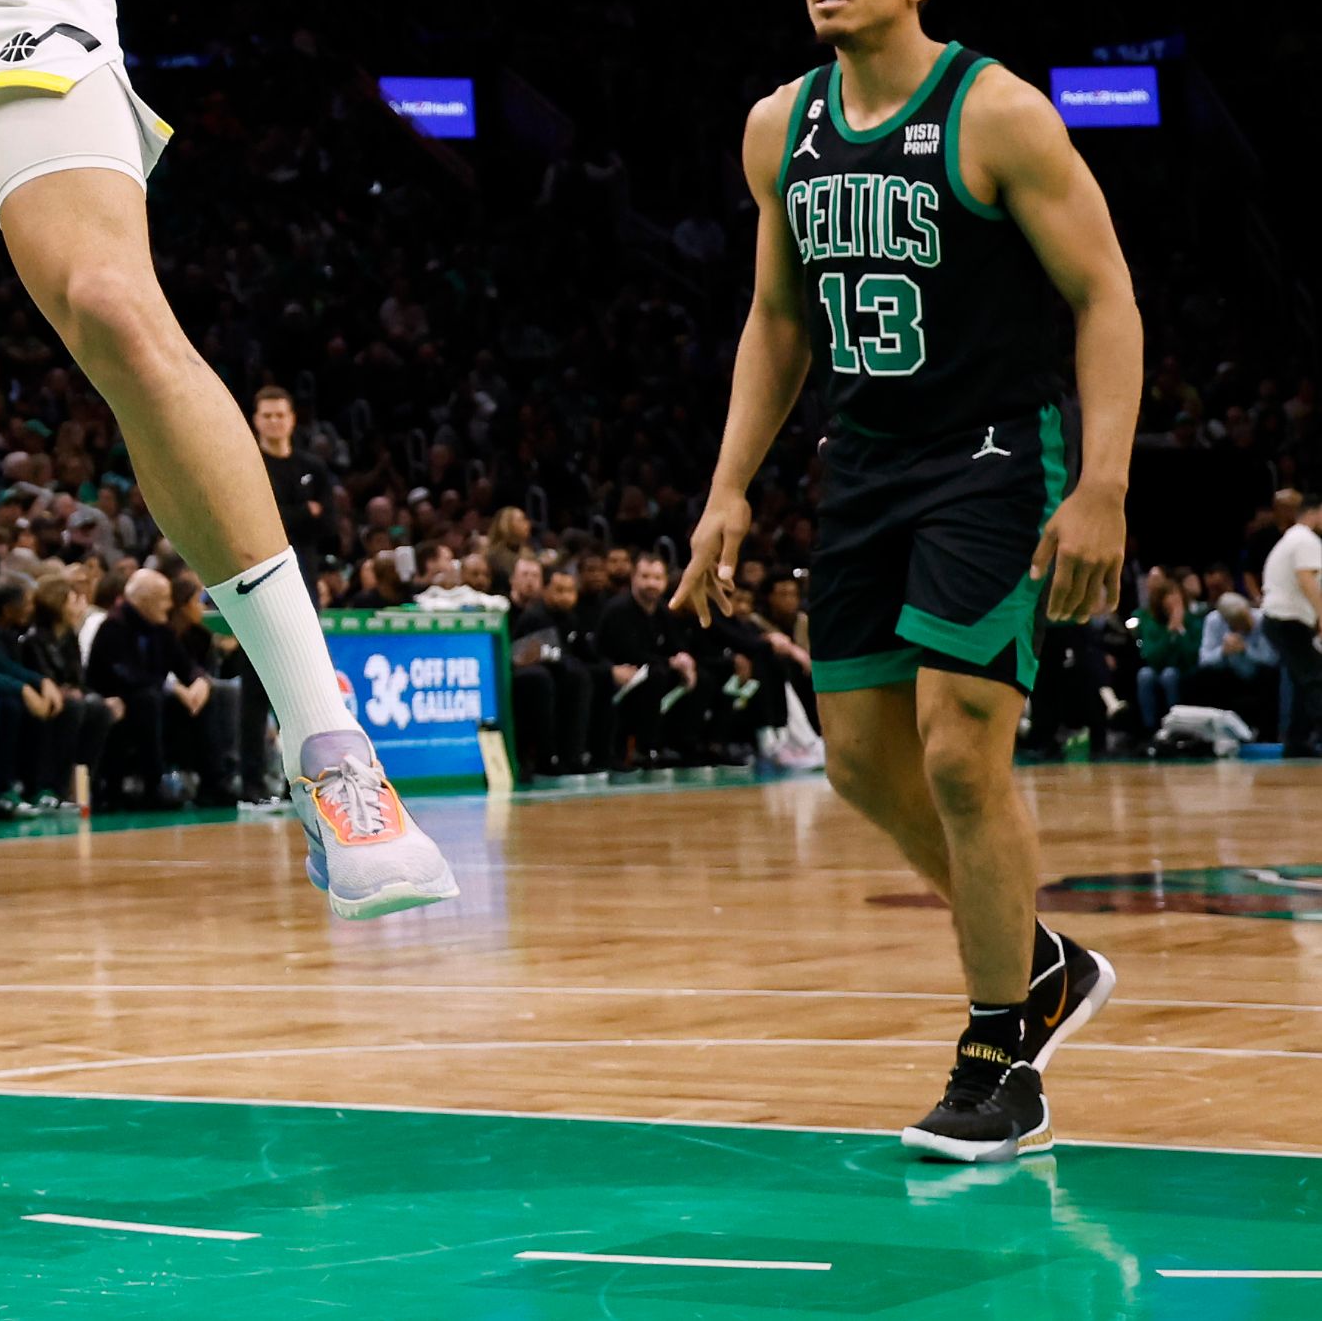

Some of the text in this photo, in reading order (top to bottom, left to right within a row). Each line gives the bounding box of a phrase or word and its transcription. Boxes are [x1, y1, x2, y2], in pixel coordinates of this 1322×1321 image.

[807, 99, 824, 120] 6
[904, 123, 940, 143] VISTA
[903, 140, 940, 157] PRINT
[786, 173, 942, 268] CELTICS
[818, 272, 926, 376] 13
[410, 657, 445, 690] OFF
